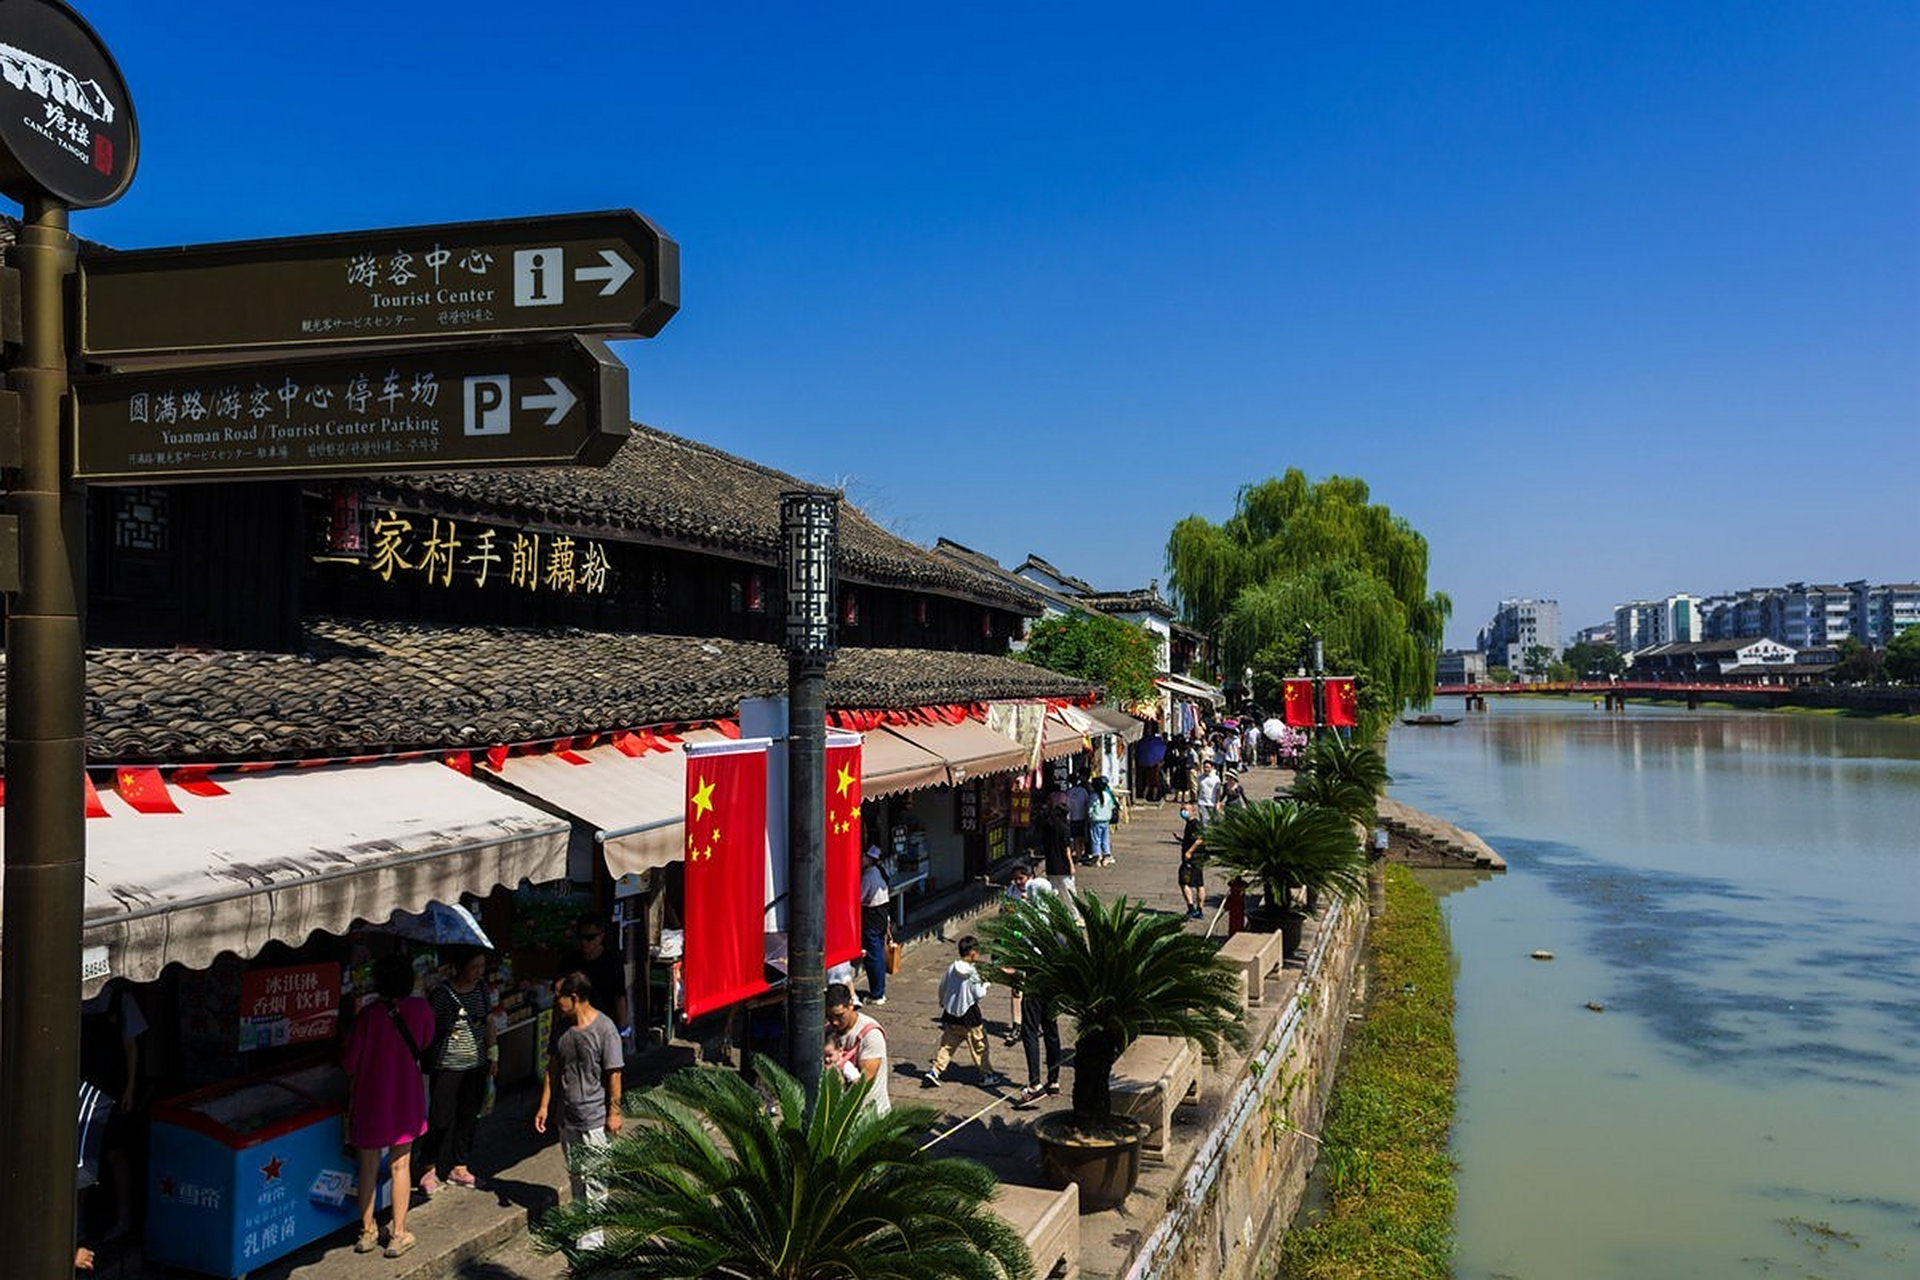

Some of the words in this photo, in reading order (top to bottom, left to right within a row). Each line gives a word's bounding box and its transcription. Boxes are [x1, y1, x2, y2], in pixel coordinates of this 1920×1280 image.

[23, 116, 54, 141] CANAL
[57, 136, 90, 165] TANGQI
[346, 243, 498, 288] 游客中心
[371, 292, 431, 309] Tourist
[436, 287, 496, 306] Center
[344, 367, 441, 415] 停车场
[161, 429, 220, 446] Yuanman
[223, 424, 258, 442] Road
[325, 418, 376, 436] Center
[380, 414, 440, 435] Parking
[252, 994, 287, 1016] 香烟
[295, 988, 330, 1010] 饮料
[264, 971, 319, 995] 冰淇淋
[242, 1214, 296, 1259] 乳酸菌
